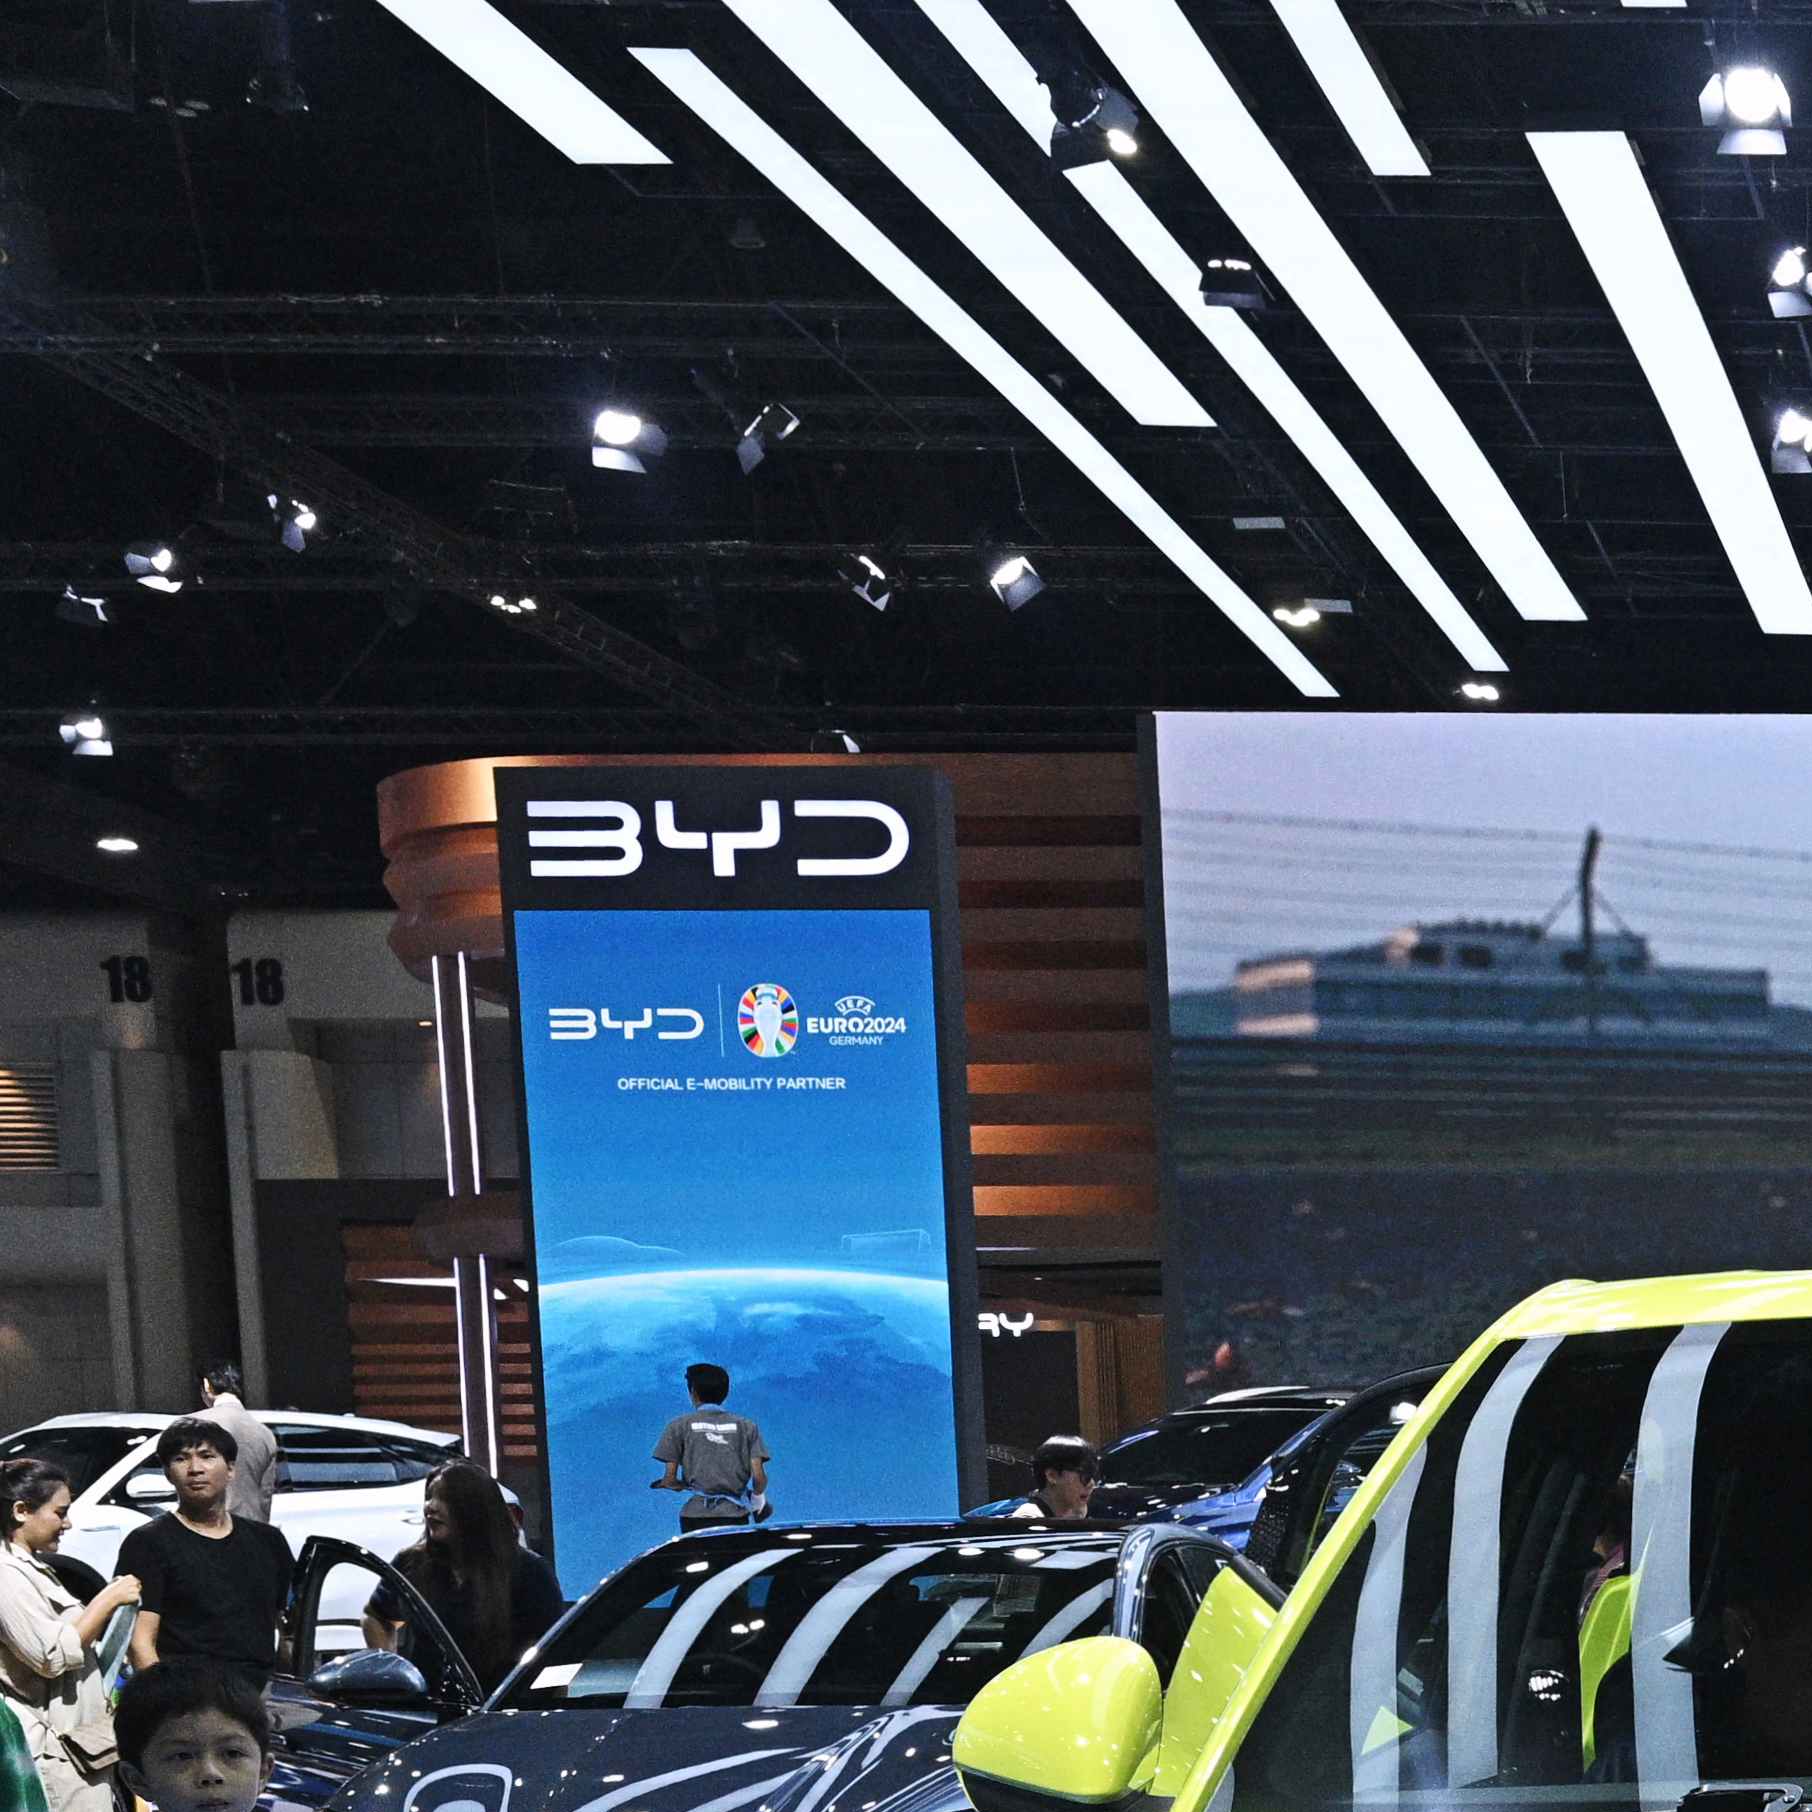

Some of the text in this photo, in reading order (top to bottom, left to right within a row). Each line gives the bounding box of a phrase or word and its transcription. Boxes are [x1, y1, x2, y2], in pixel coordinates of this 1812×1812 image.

[526, 800, 910, 877] BYD
[101, 955, 151, 1002] 18
[232, 958, 284, 1005] 18
[837, 1000, 872, 1014] UEFA
[549, 1008, 704, 1039] BYD
[806, 1017, 907, 1034] EURO2024
[829, 1036, 883, 1046] GERMANY
[617, 1077, 846, 1091] OFFICIAL E-MOBILITY PARTNER
